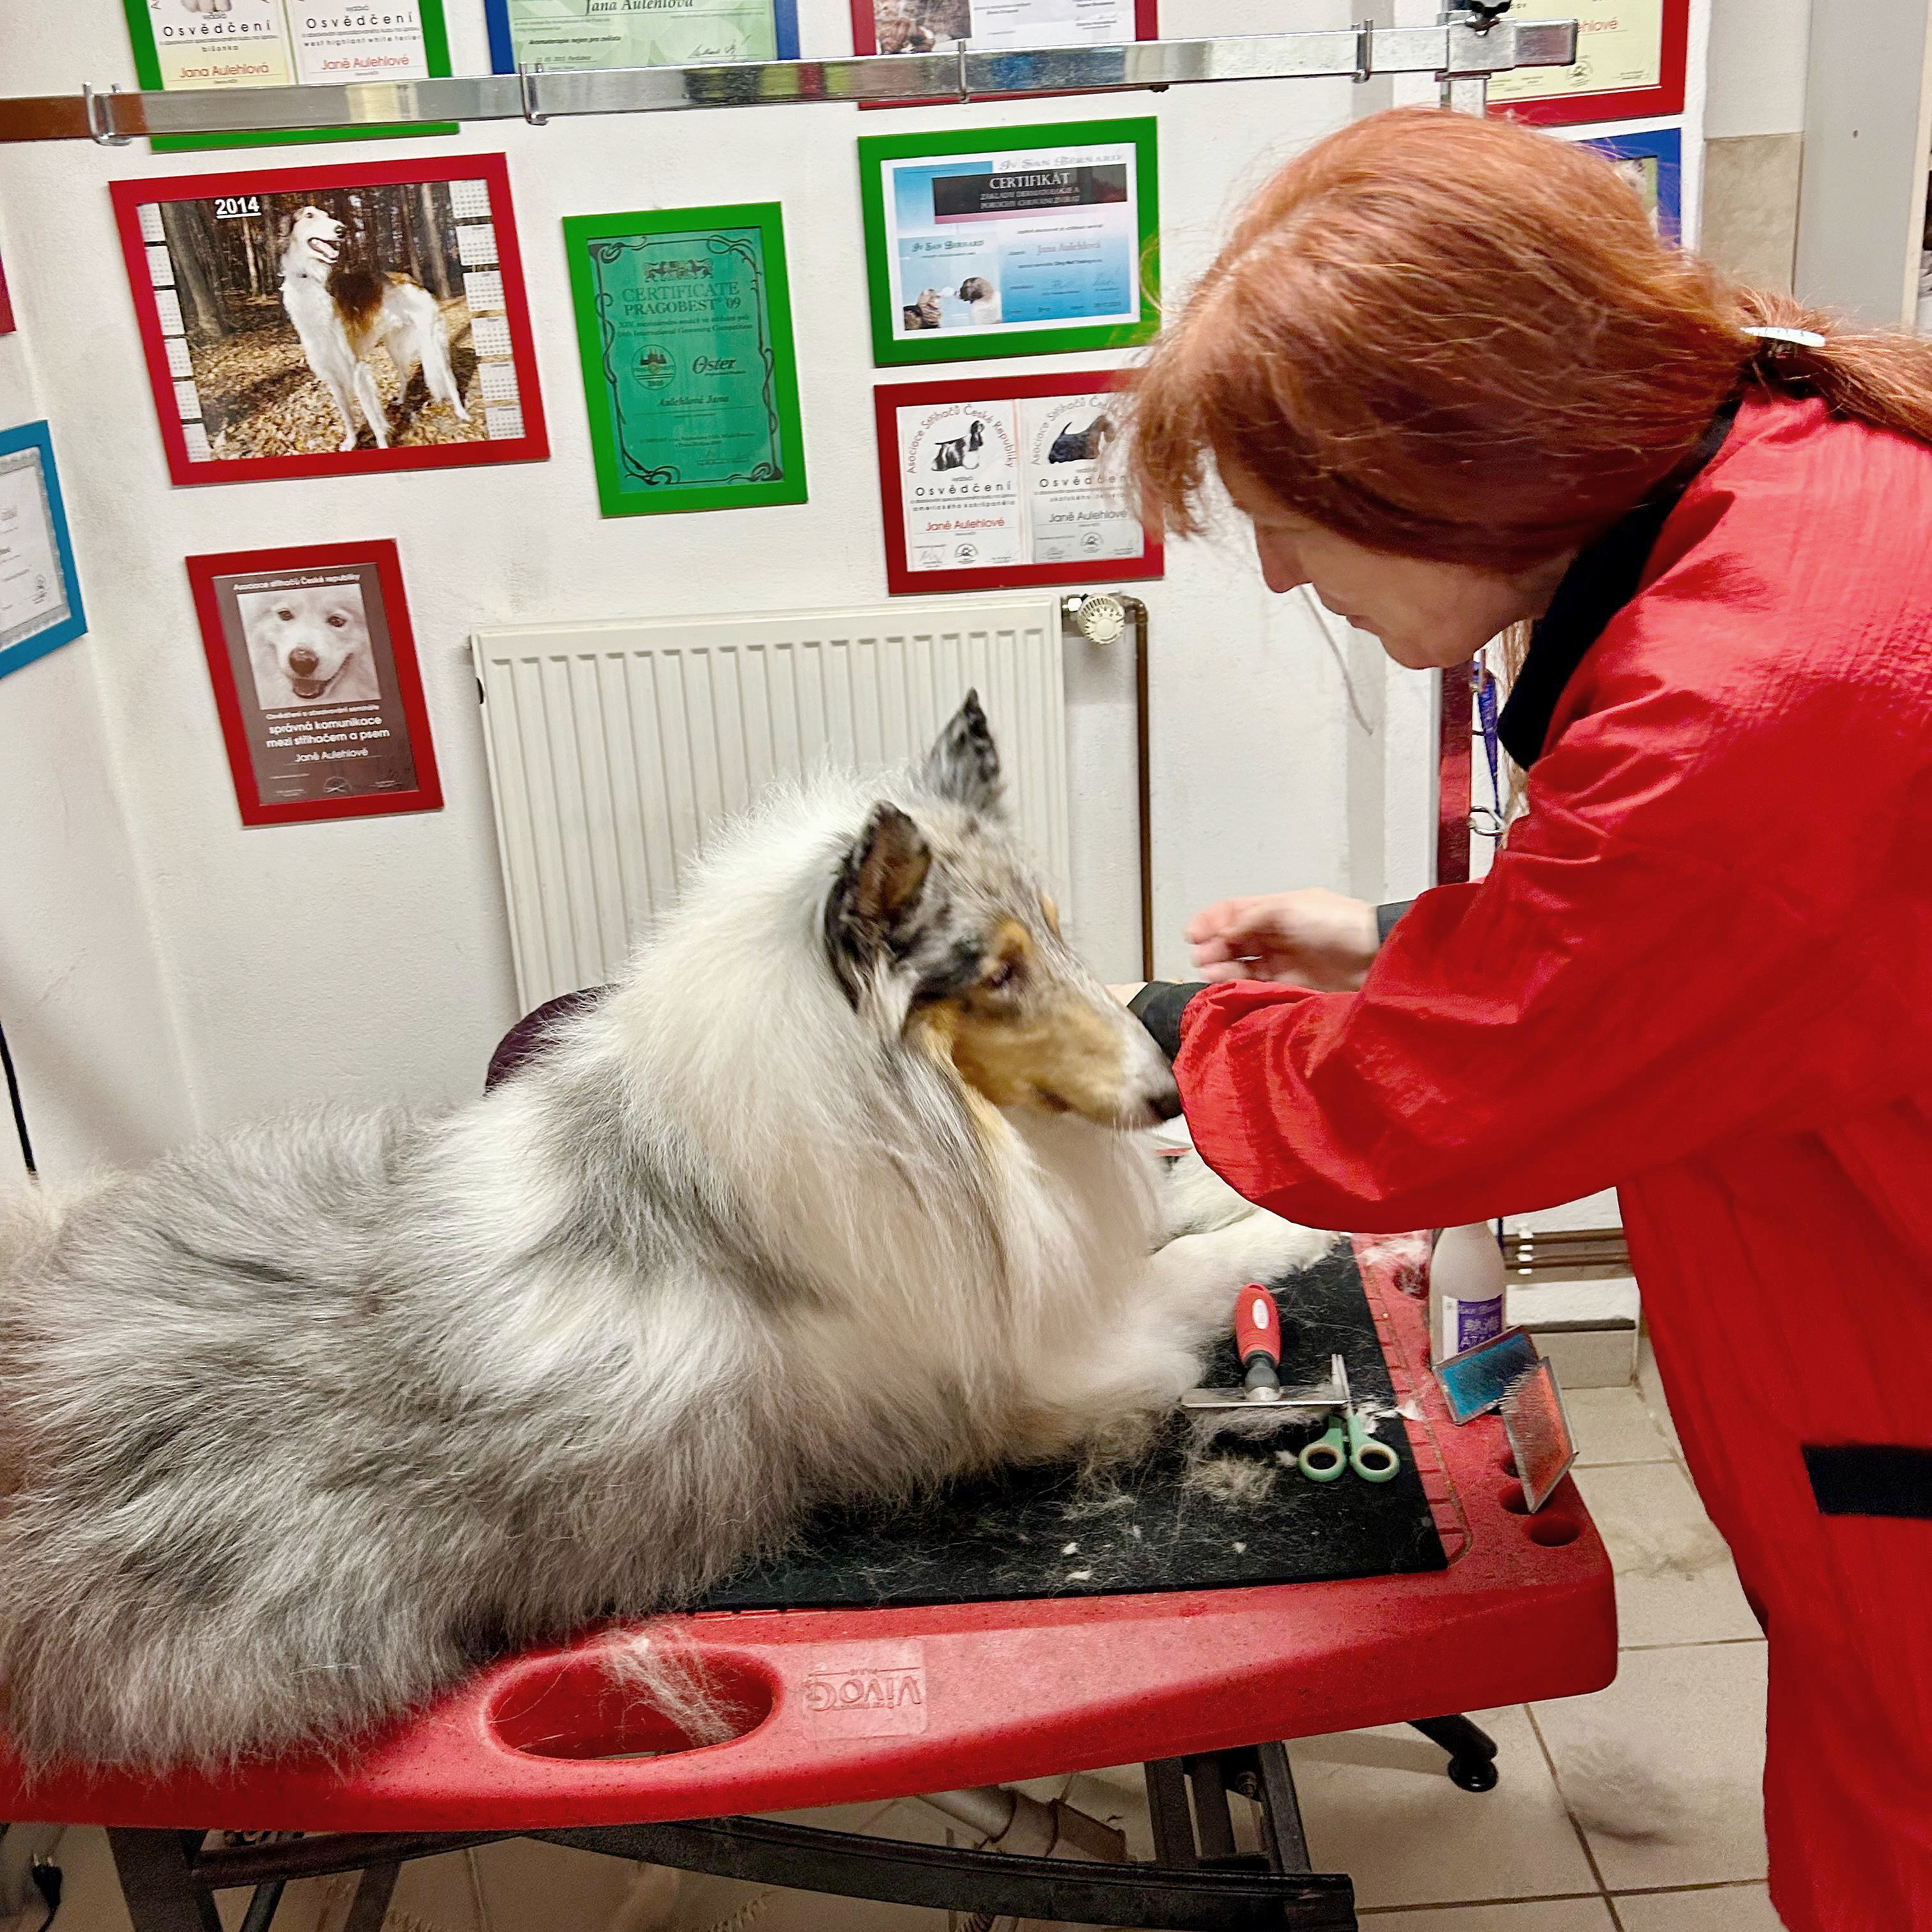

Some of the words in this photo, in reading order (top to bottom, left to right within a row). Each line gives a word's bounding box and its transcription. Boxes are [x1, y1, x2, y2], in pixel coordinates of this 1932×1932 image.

[164, 20, 271, 36] Osvědčení
[306, 12, 413, 29] Osvědčení
[990, 172, 1071, 189] CERTIFIKÁT
[215, 196, 260, 215] 2014
[622, 282, 740, 302] CERTIFICATE
[693, 356, 736, 374] Oster
[916, 480, 1011, 496] Osvědčení
[314, 717, 383, 730] komunikace
[266, 737, 293, 748] mezi
[349, 732, 358, 740] a
[359, 730, 390, 740] psem
[805, 1675, 922, 1712] VIVOG
